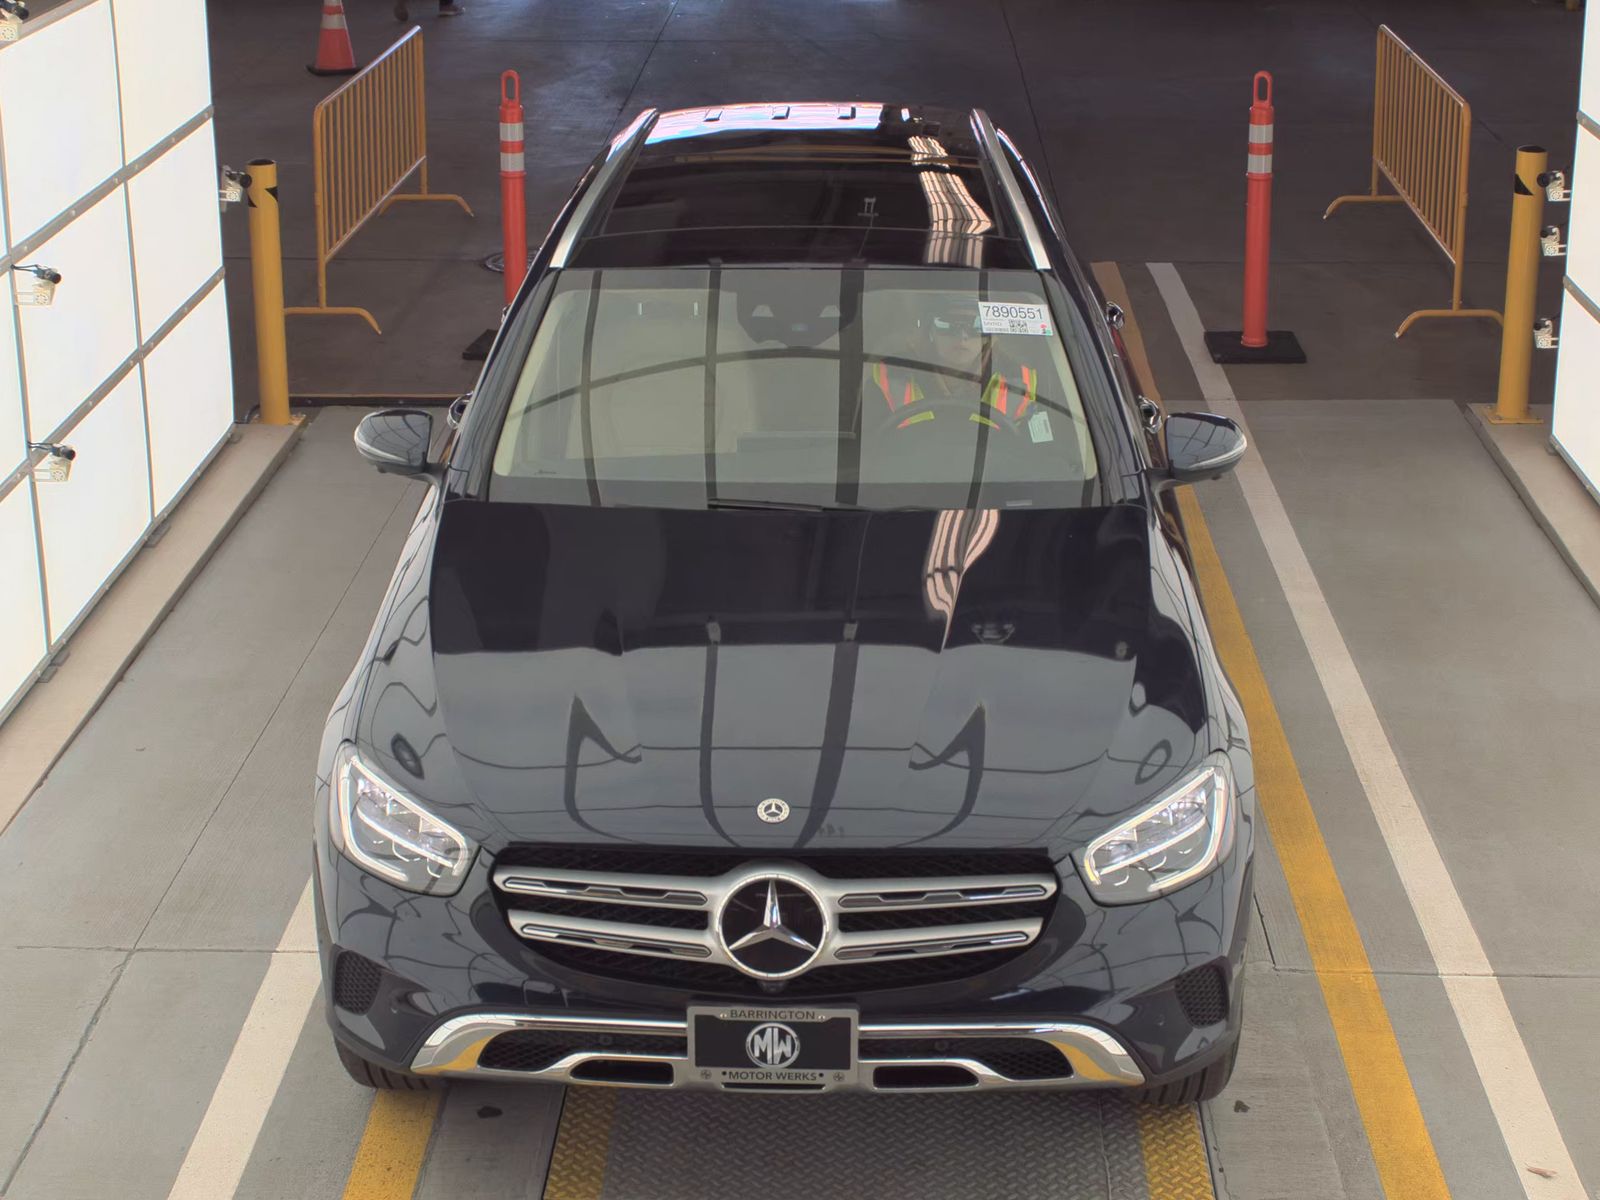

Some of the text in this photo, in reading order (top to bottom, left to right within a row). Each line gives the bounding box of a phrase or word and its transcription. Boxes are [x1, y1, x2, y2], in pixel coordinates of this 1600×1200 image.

[983, 305, 1042, 320] 7890551
[730, 1009, 815, 1021] BARRINGTON
[728, 1071, 817, 1082] MOTOR WERKS
